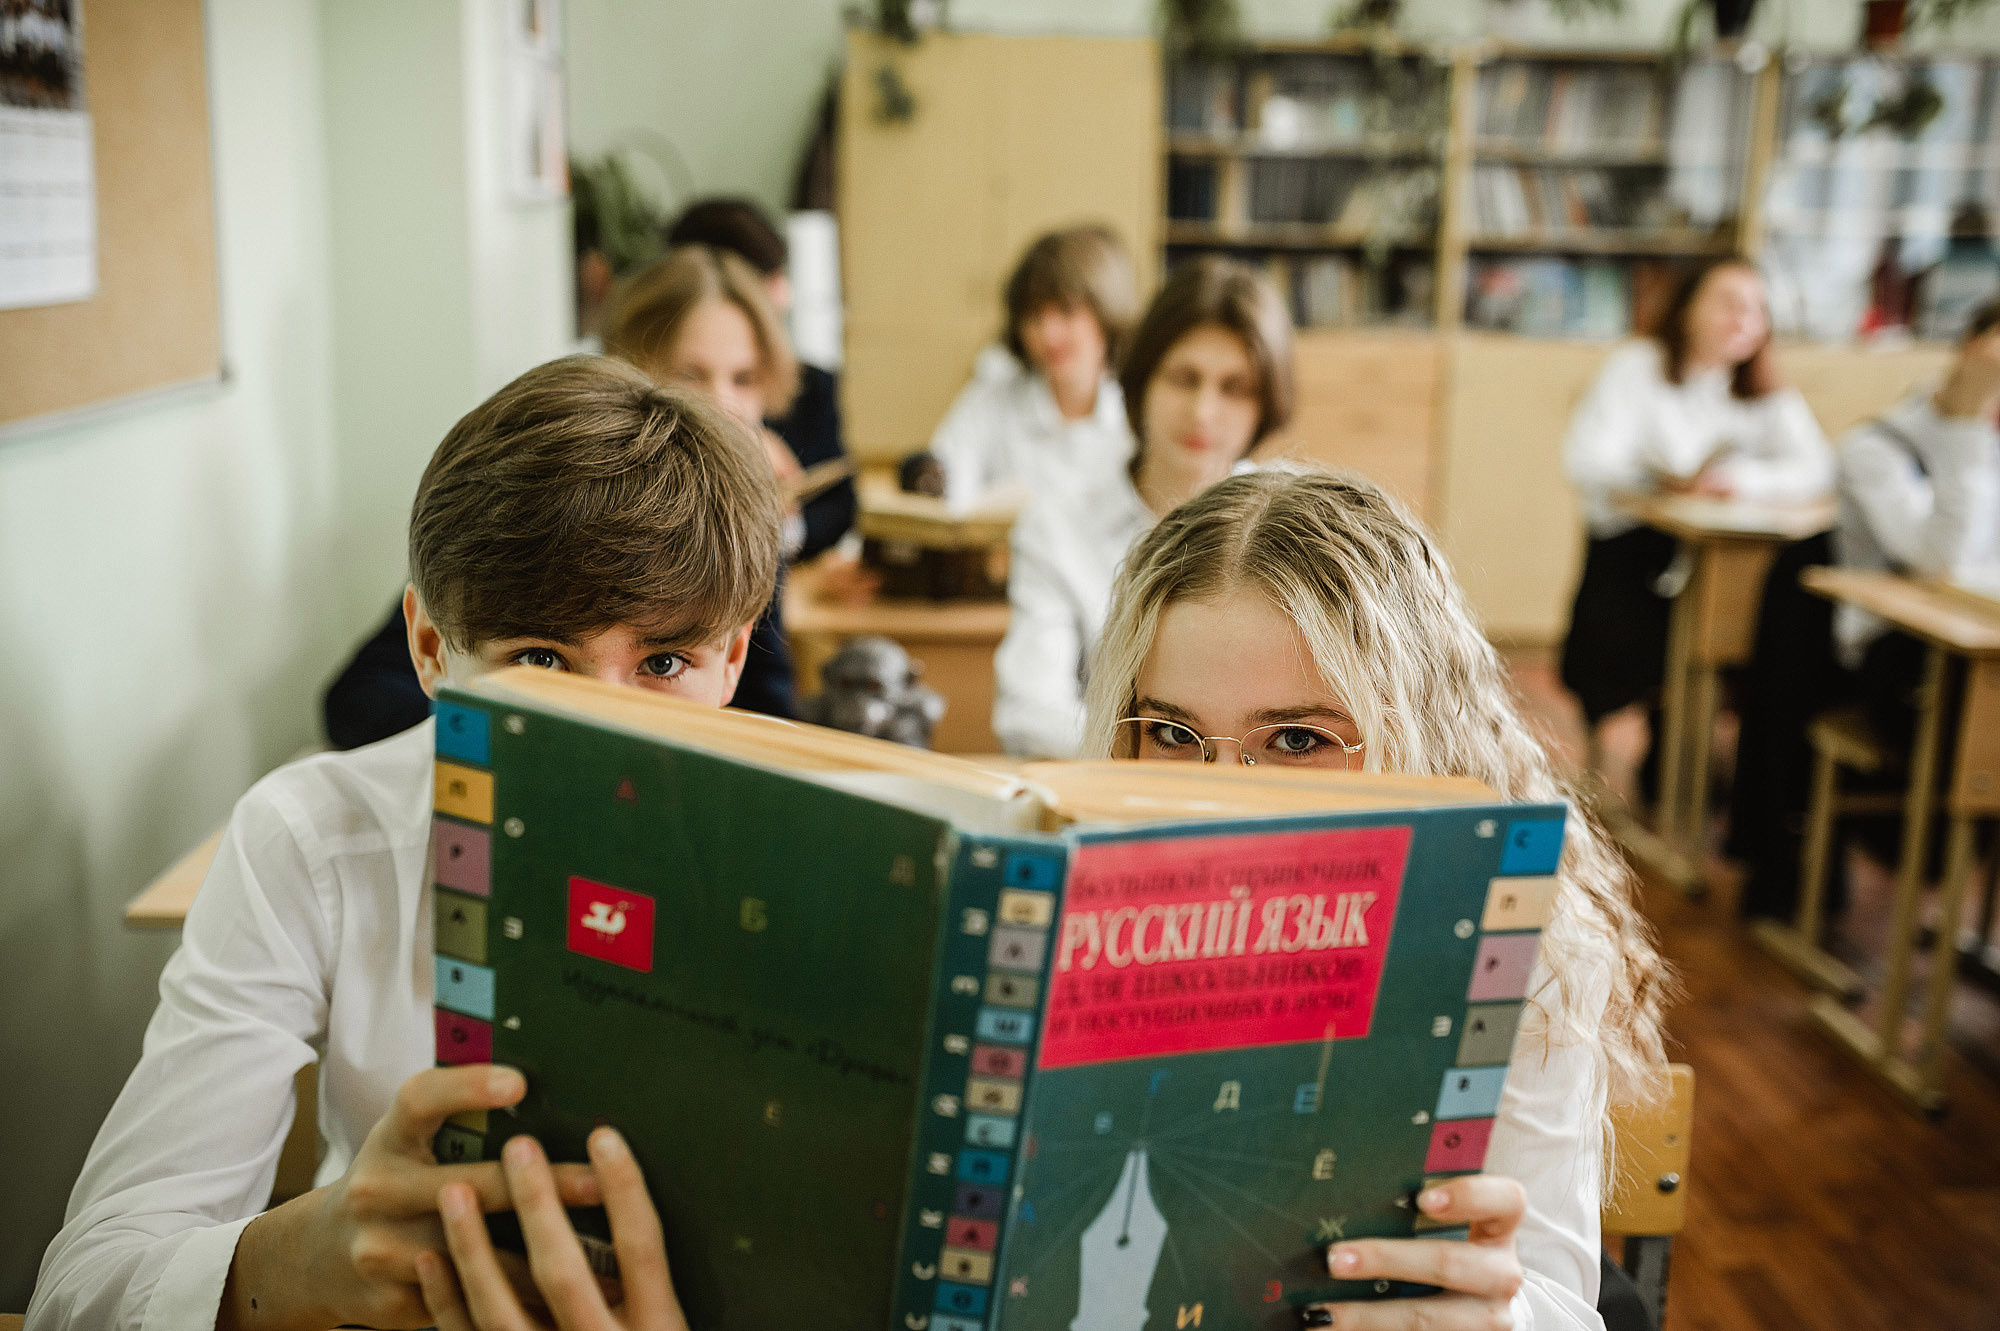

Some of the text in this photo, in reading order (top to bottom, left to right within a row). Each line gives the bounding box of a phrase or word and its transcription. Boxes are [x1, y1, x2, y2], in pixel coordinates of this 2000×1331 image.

[1058, 885, 1377, 972] РУССКИЙ ЯЗЫК
[1213, 1080, 1241, 1113] Д
[1293, 1083, 1320, 1114] Е
[1316, 1215, 1347, 1242] Ж
[1263, 1280, 1282, 1302] З
[1177, 1302, 1204, 1329] И
